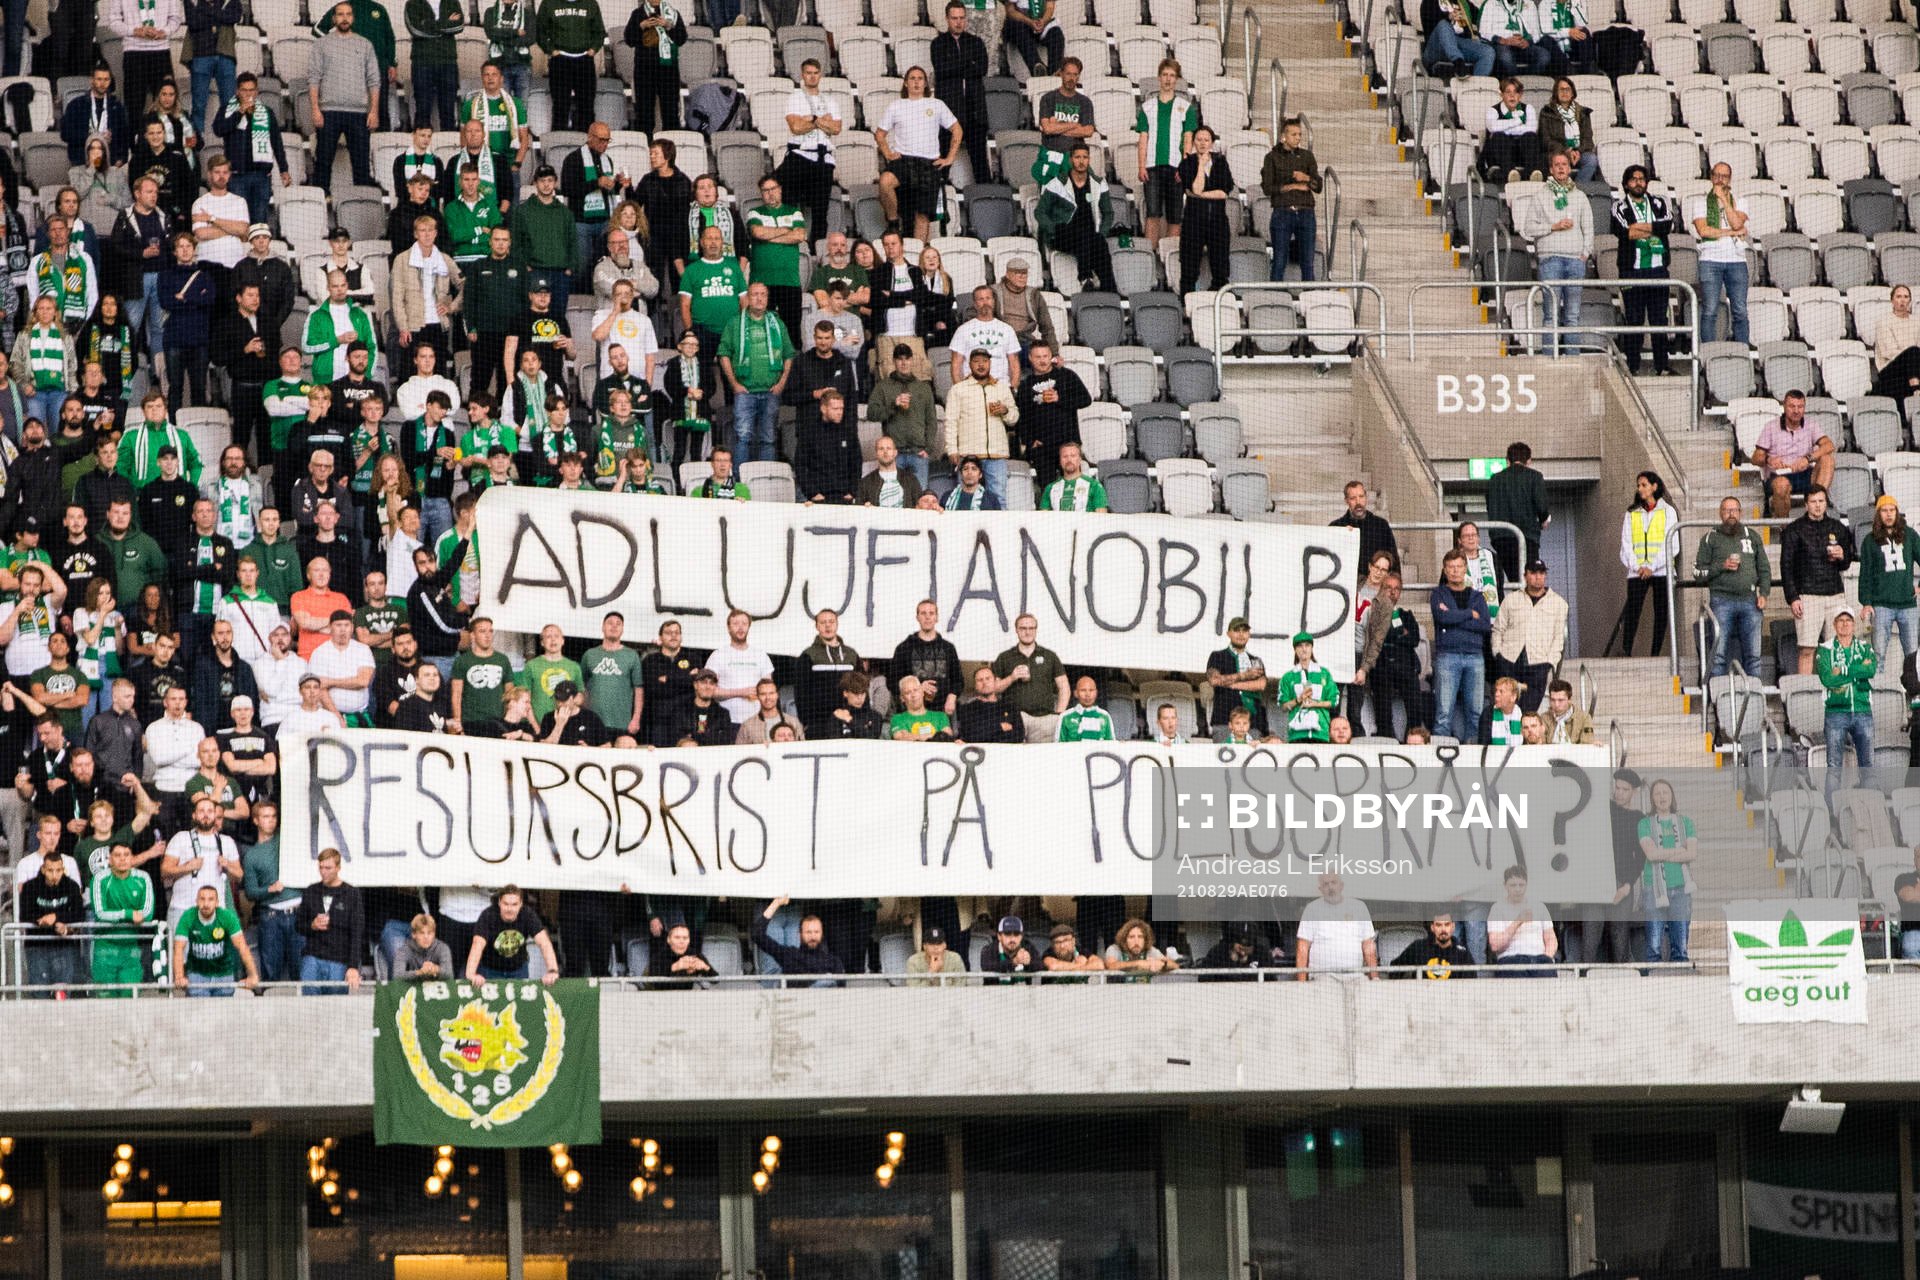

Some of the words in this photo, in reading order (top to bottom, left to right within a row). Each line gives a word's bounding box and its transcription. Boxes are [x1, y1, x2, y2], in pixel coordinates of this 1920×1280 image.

[701, 285, 734, 297] ERIKS
[971, 329, 1003, 338] BAJEN
[1436, 374, 1538, 413] B335
[1741, 538, 1754, 554] H
[1881, 544, 1906, 573] H
[365, 611, 398, 622] BAJEN
[307, 738, 850, 876] RESURSBRIST
[920, 745, 994, 870] PÅ
[1744, 986, 1799, 1007] aeg
[1806, 981, 1852, 1001] out
[452, 1072, 512, 1106] 128
[1790, 1194, 1899, 1235] SPRIN
